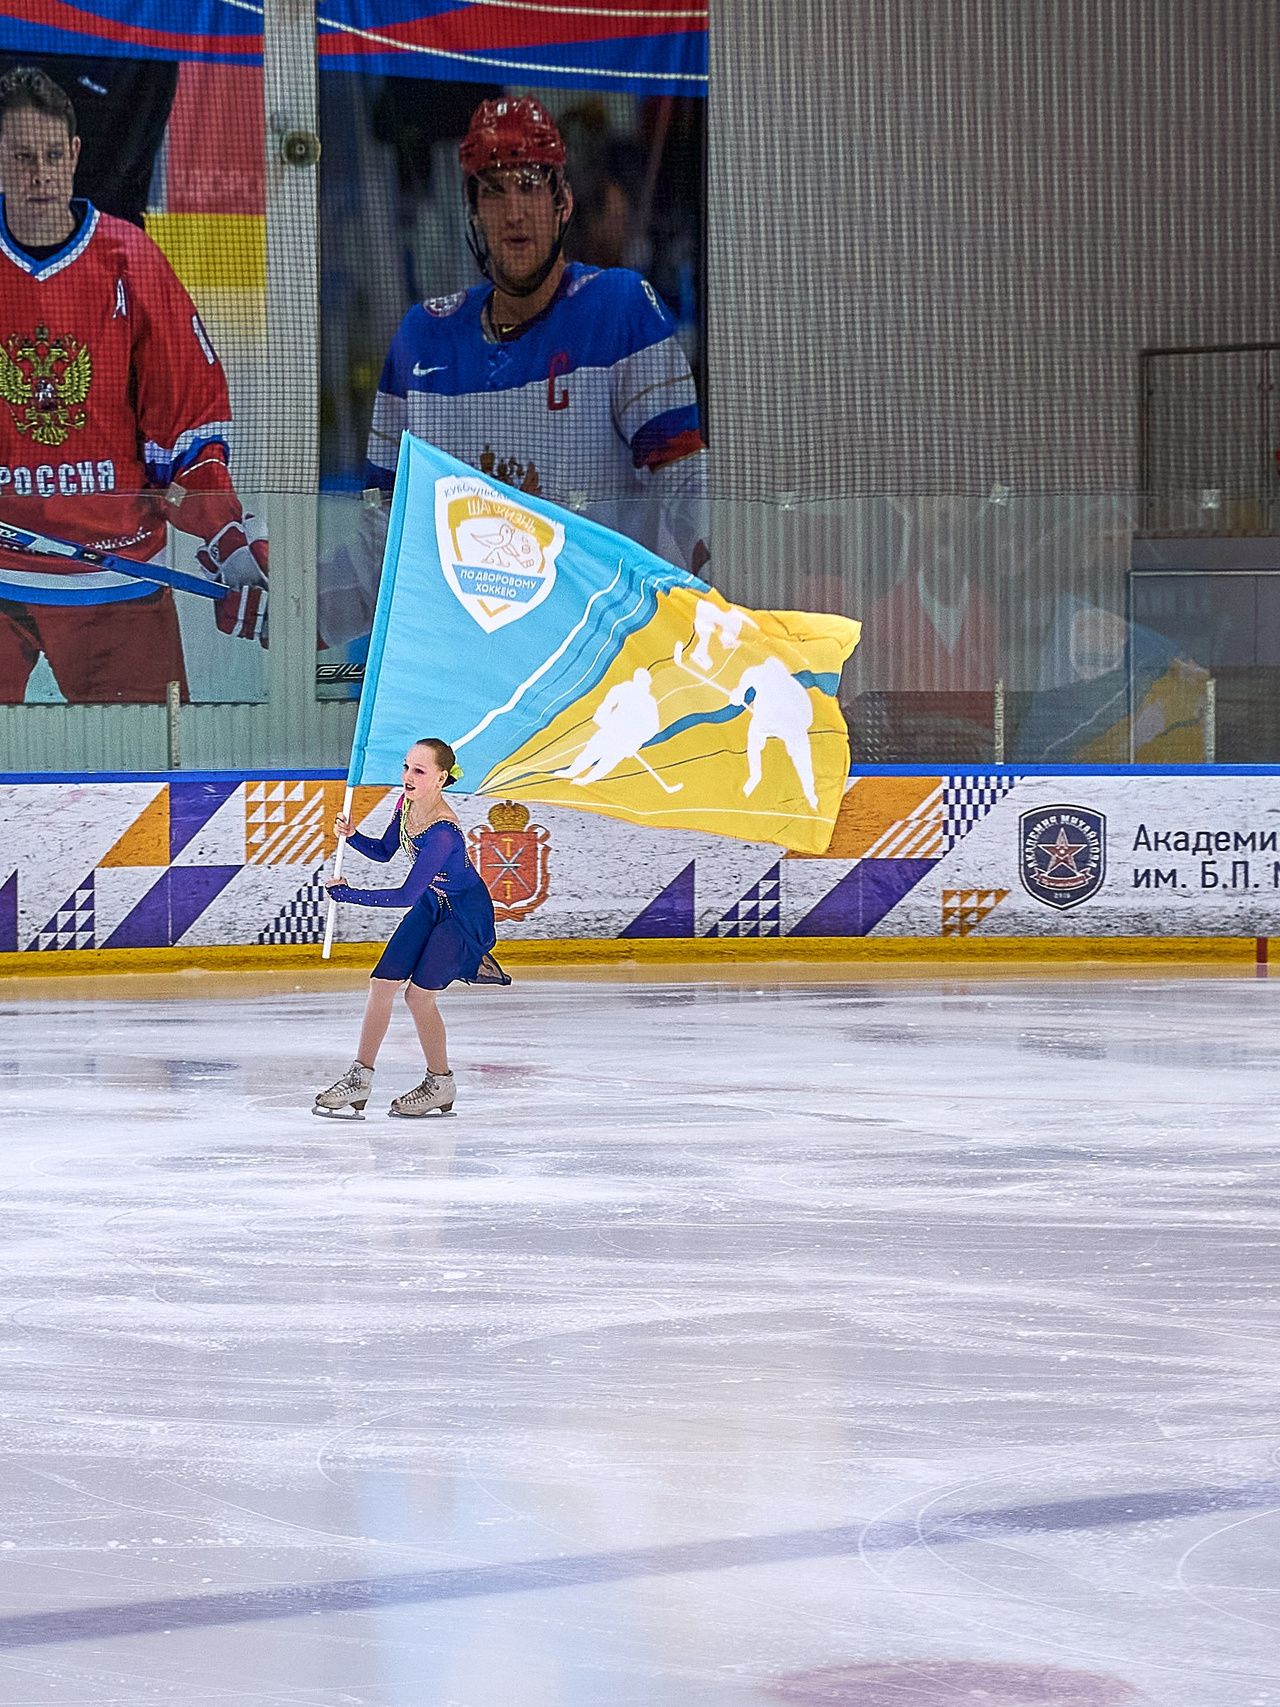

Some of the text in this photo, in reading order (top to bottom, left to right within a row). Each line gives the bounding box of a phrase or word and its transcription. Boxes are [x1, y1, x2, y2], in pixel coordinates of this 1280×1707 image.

[460, 570, 537, 590] ПО ДВОРОВОМУ
[475, 583, 517, 598] ХОККЕЮ
[1132, 824, 1277, 855] Академи
[1131, 869, 1187, 888] им.
[1201, 860, 1260, 888] Б.П.
